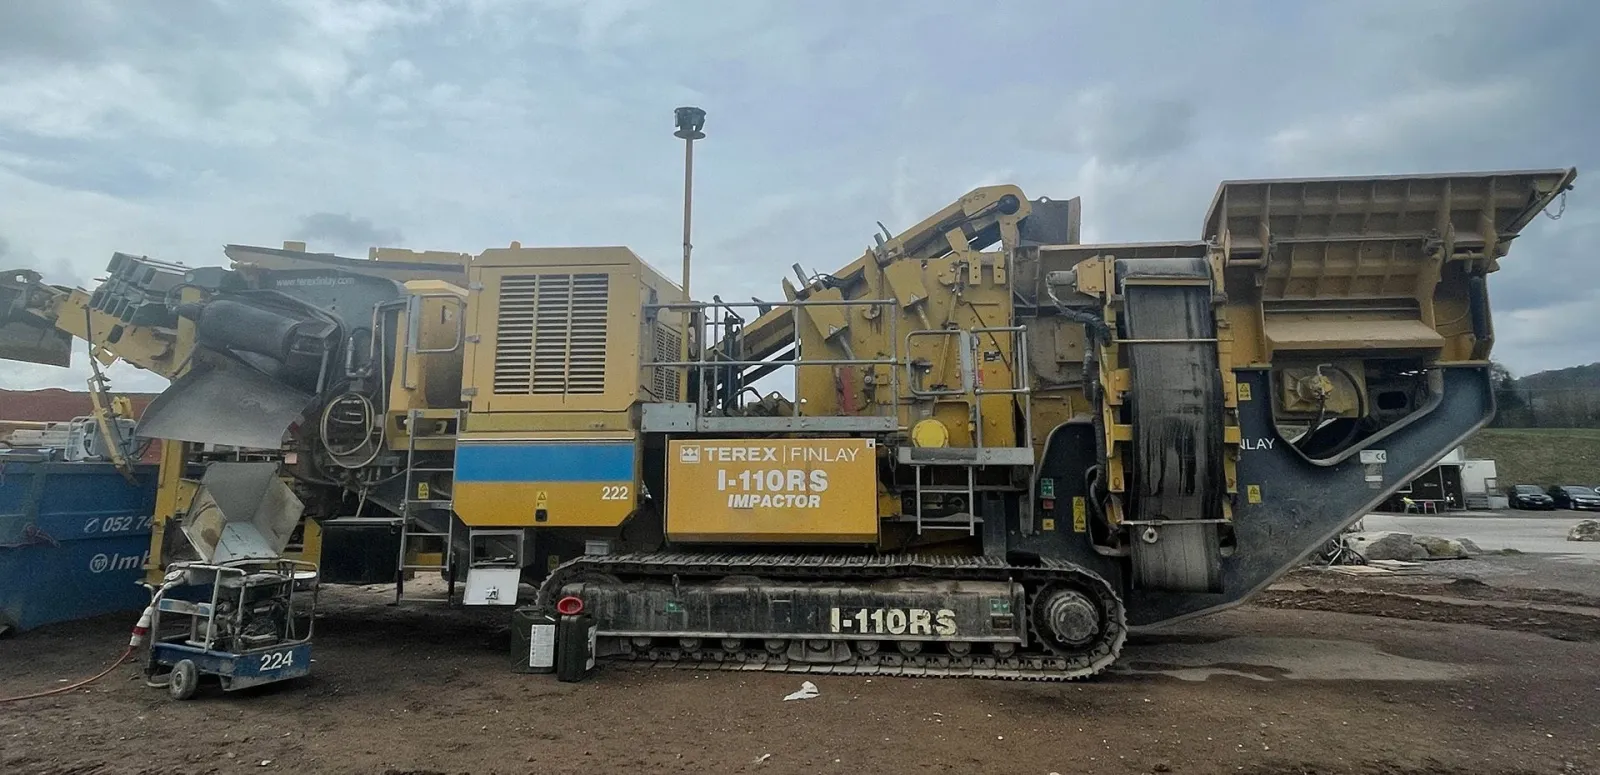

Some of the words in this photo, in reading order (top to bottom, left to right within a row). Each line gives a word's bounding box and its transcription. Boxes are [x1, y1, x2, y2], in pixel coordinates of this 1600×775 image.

[704, 447, 778, 462] TEREX
[791, 447, 859, 462] FINLAY
[717, 469, 828, 492] I-110RS
[601, 485, 629, 500] 222
[727, 494, 821, 508] IMPACTOR
[102, 516, 133, 532] 052
[830, 607, 957, 635] I-110RS
[259, 650, 294, 672] 224
